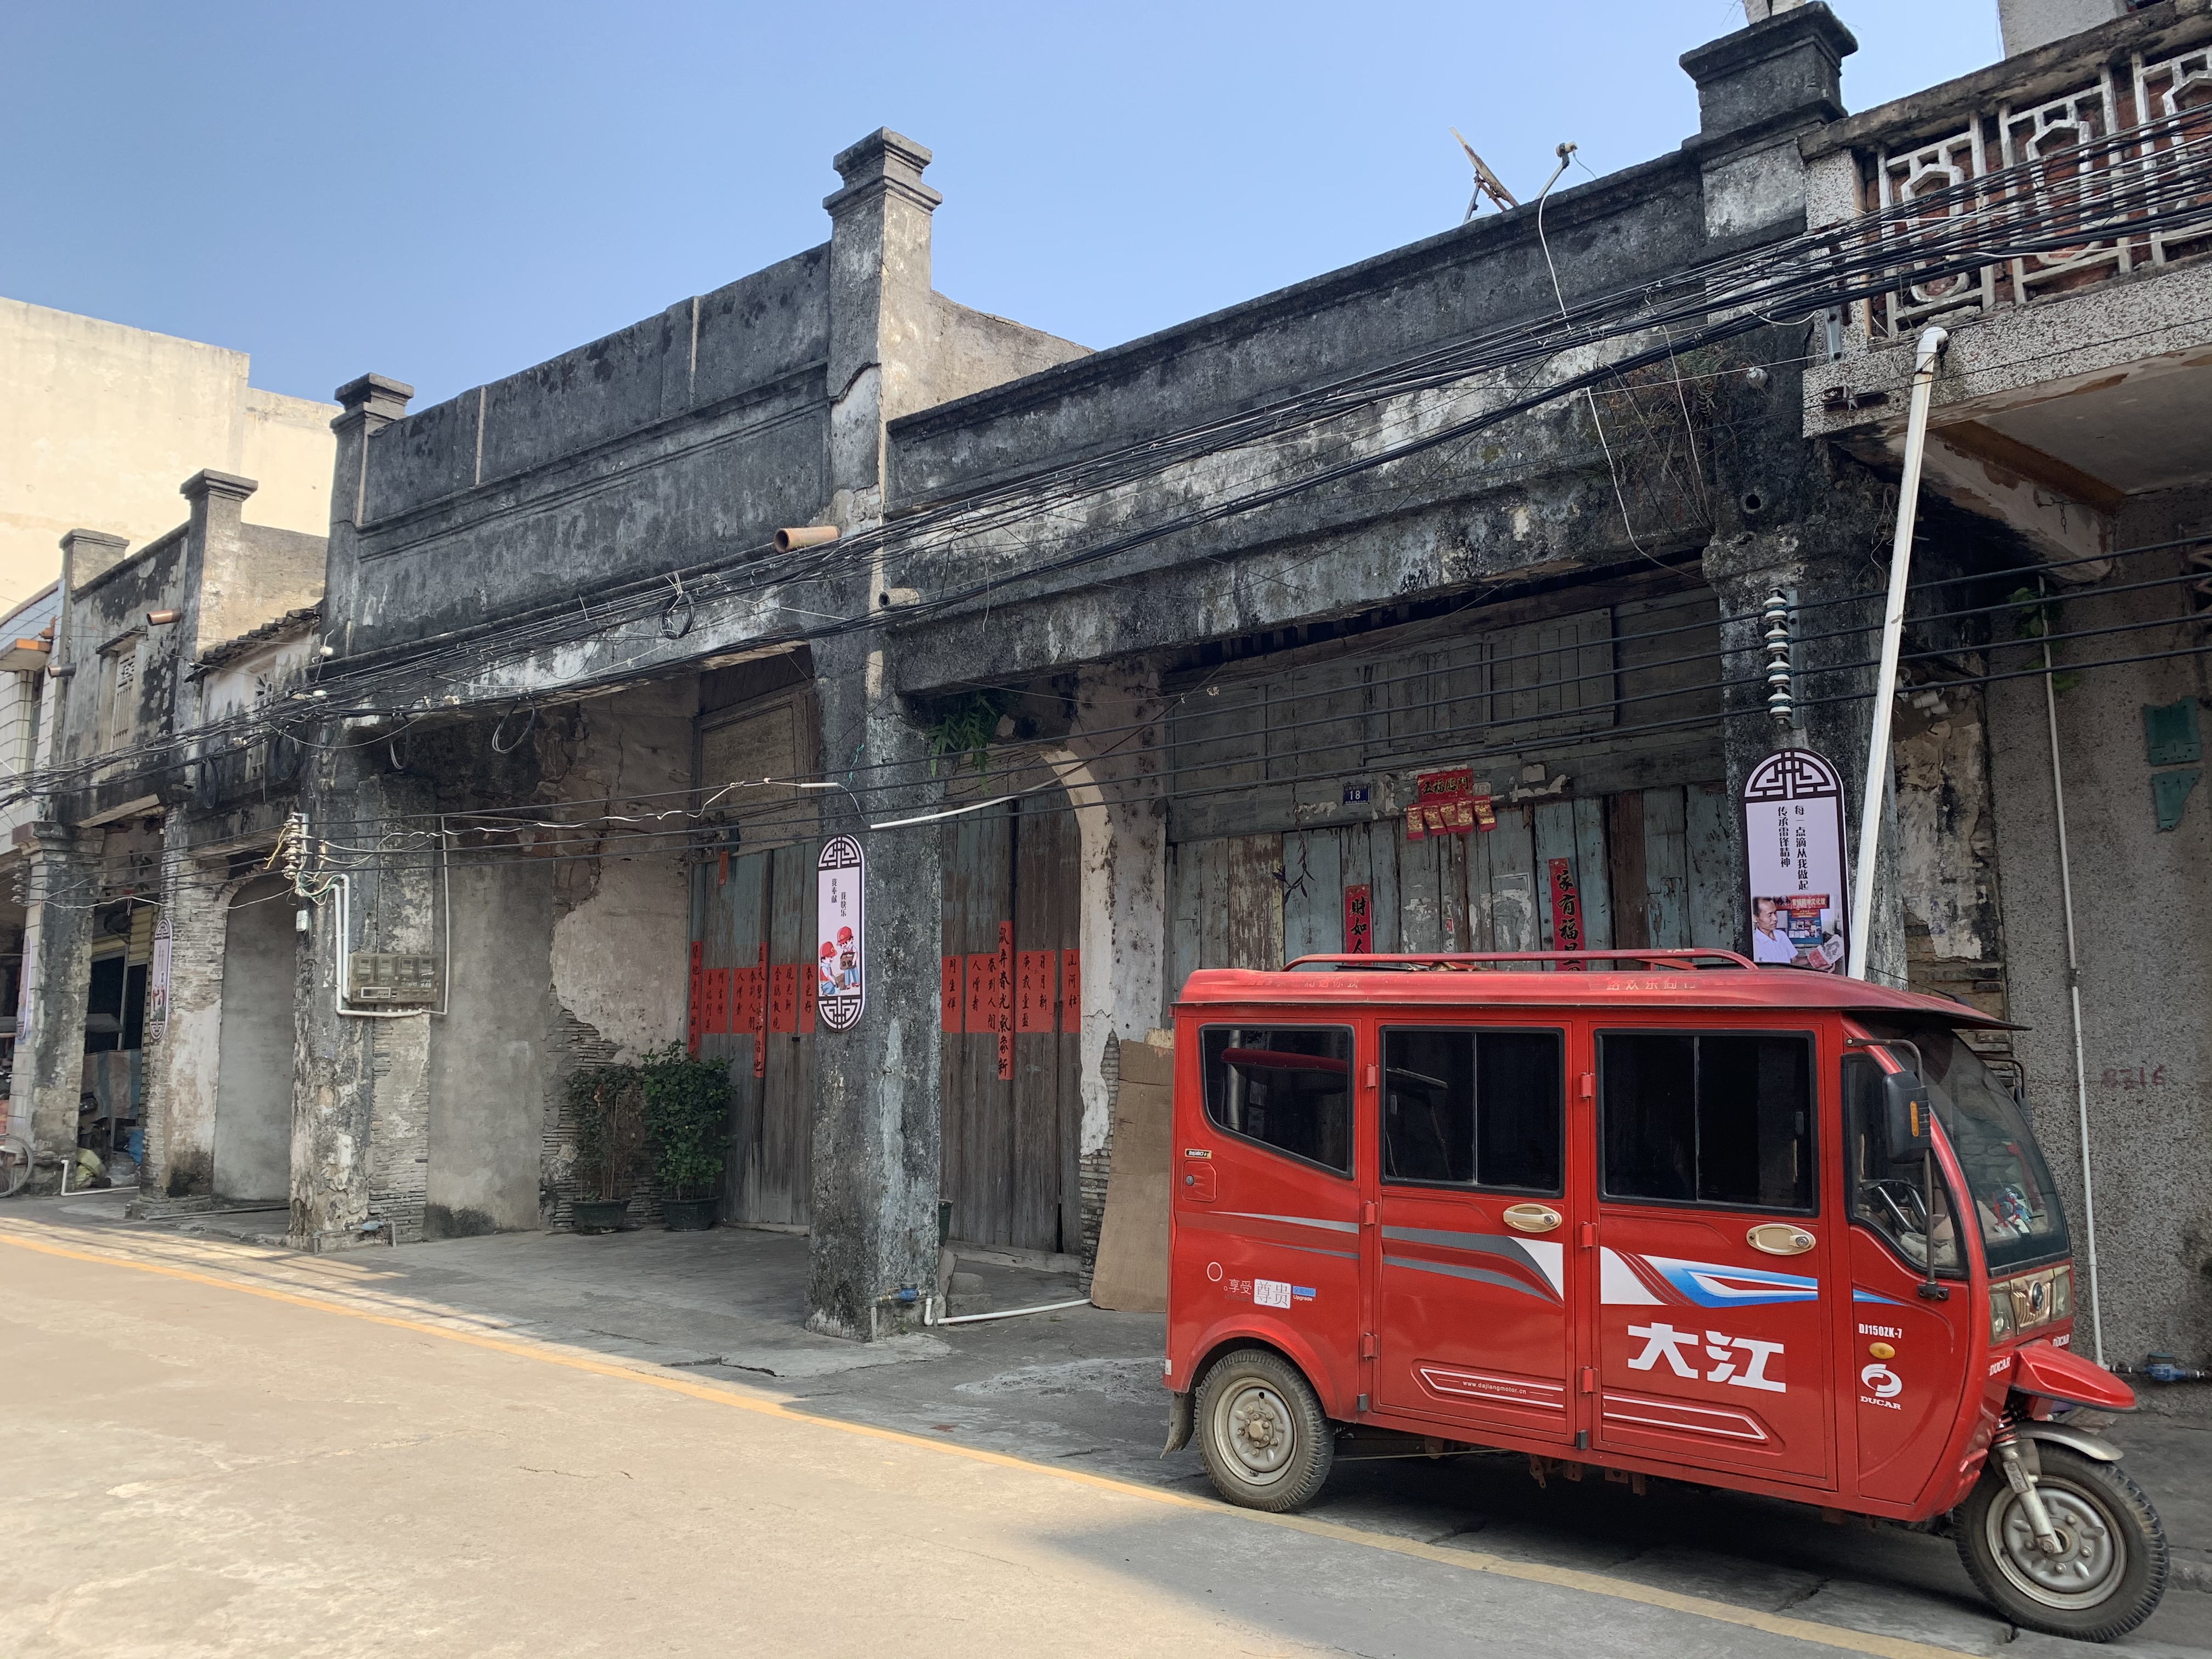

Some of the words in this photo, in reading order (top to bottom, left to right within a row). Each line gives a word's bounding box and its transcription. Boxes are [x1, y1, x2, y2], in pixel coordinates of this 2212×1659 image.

[1350, 790, 1361, 800] 18
[1778, 806, 1791, 868] 传承雷锋精神
[1794, 805, 1809, 891] 每一点滴从我做起
[1350, 895, 1367, 966] 財如人
[1228, 1279, 1251, 1295] 享受
[1256, 1281, 1290, 1307] 尊贵
[1859, 1323, 1903, 1339] DJ150ZK-7
[1628, 1322, 1786, 1393] 大江
[1989, 1356, 2011, 1376] DUCAR
[1463, 1380, 1527, 1395] www.dajiangmotor.cn
[1860, 1396, 1902, 1410] DUCAR
